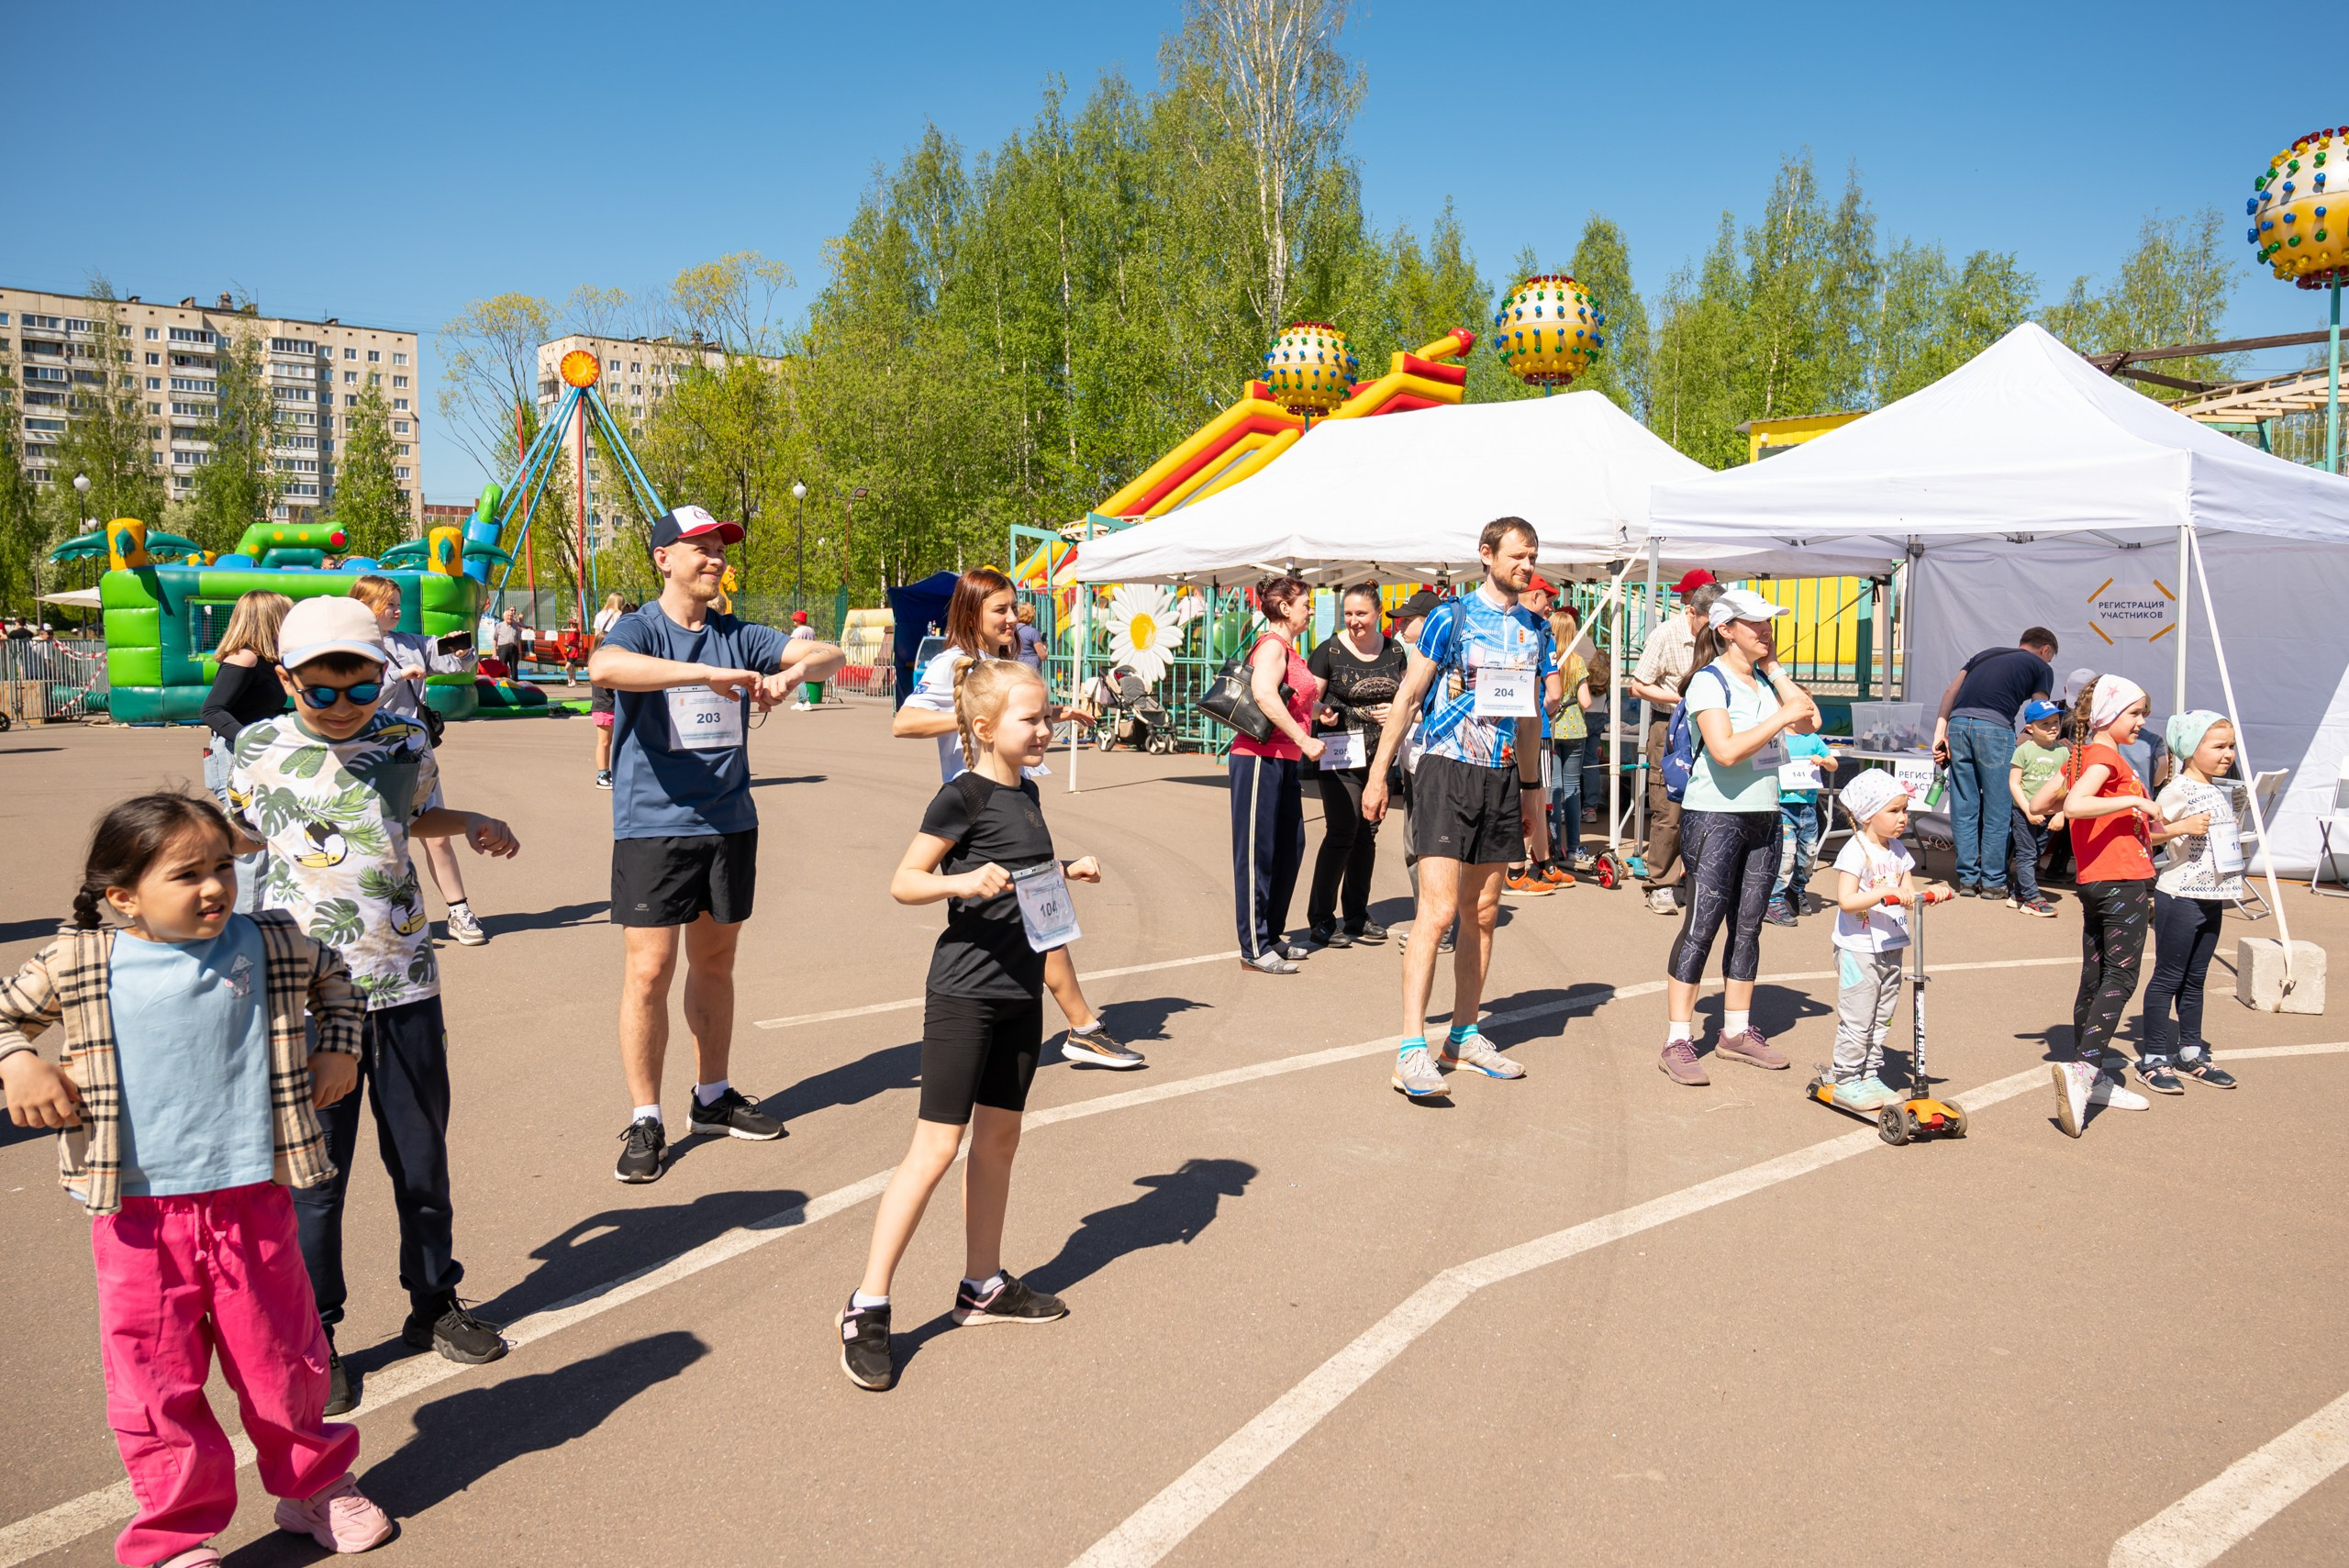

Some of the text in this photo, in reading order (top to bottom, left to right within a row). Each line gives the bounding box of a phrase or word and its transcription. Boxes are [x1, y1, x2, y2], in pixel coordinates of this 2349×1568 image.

[2099, 601, 2165, 609] РЕГИСТРАЦИЯ
[2100, 611, 2163, 619] УЧАСТНИКОВ
[1494, 687, 1514, 697] 204
[696, 712, 721, 724] 203
[1333, 748, 1350, 756] 205
[1040, 901, 1058, 917] 104
[1892, 915, 1908, 928] 106
